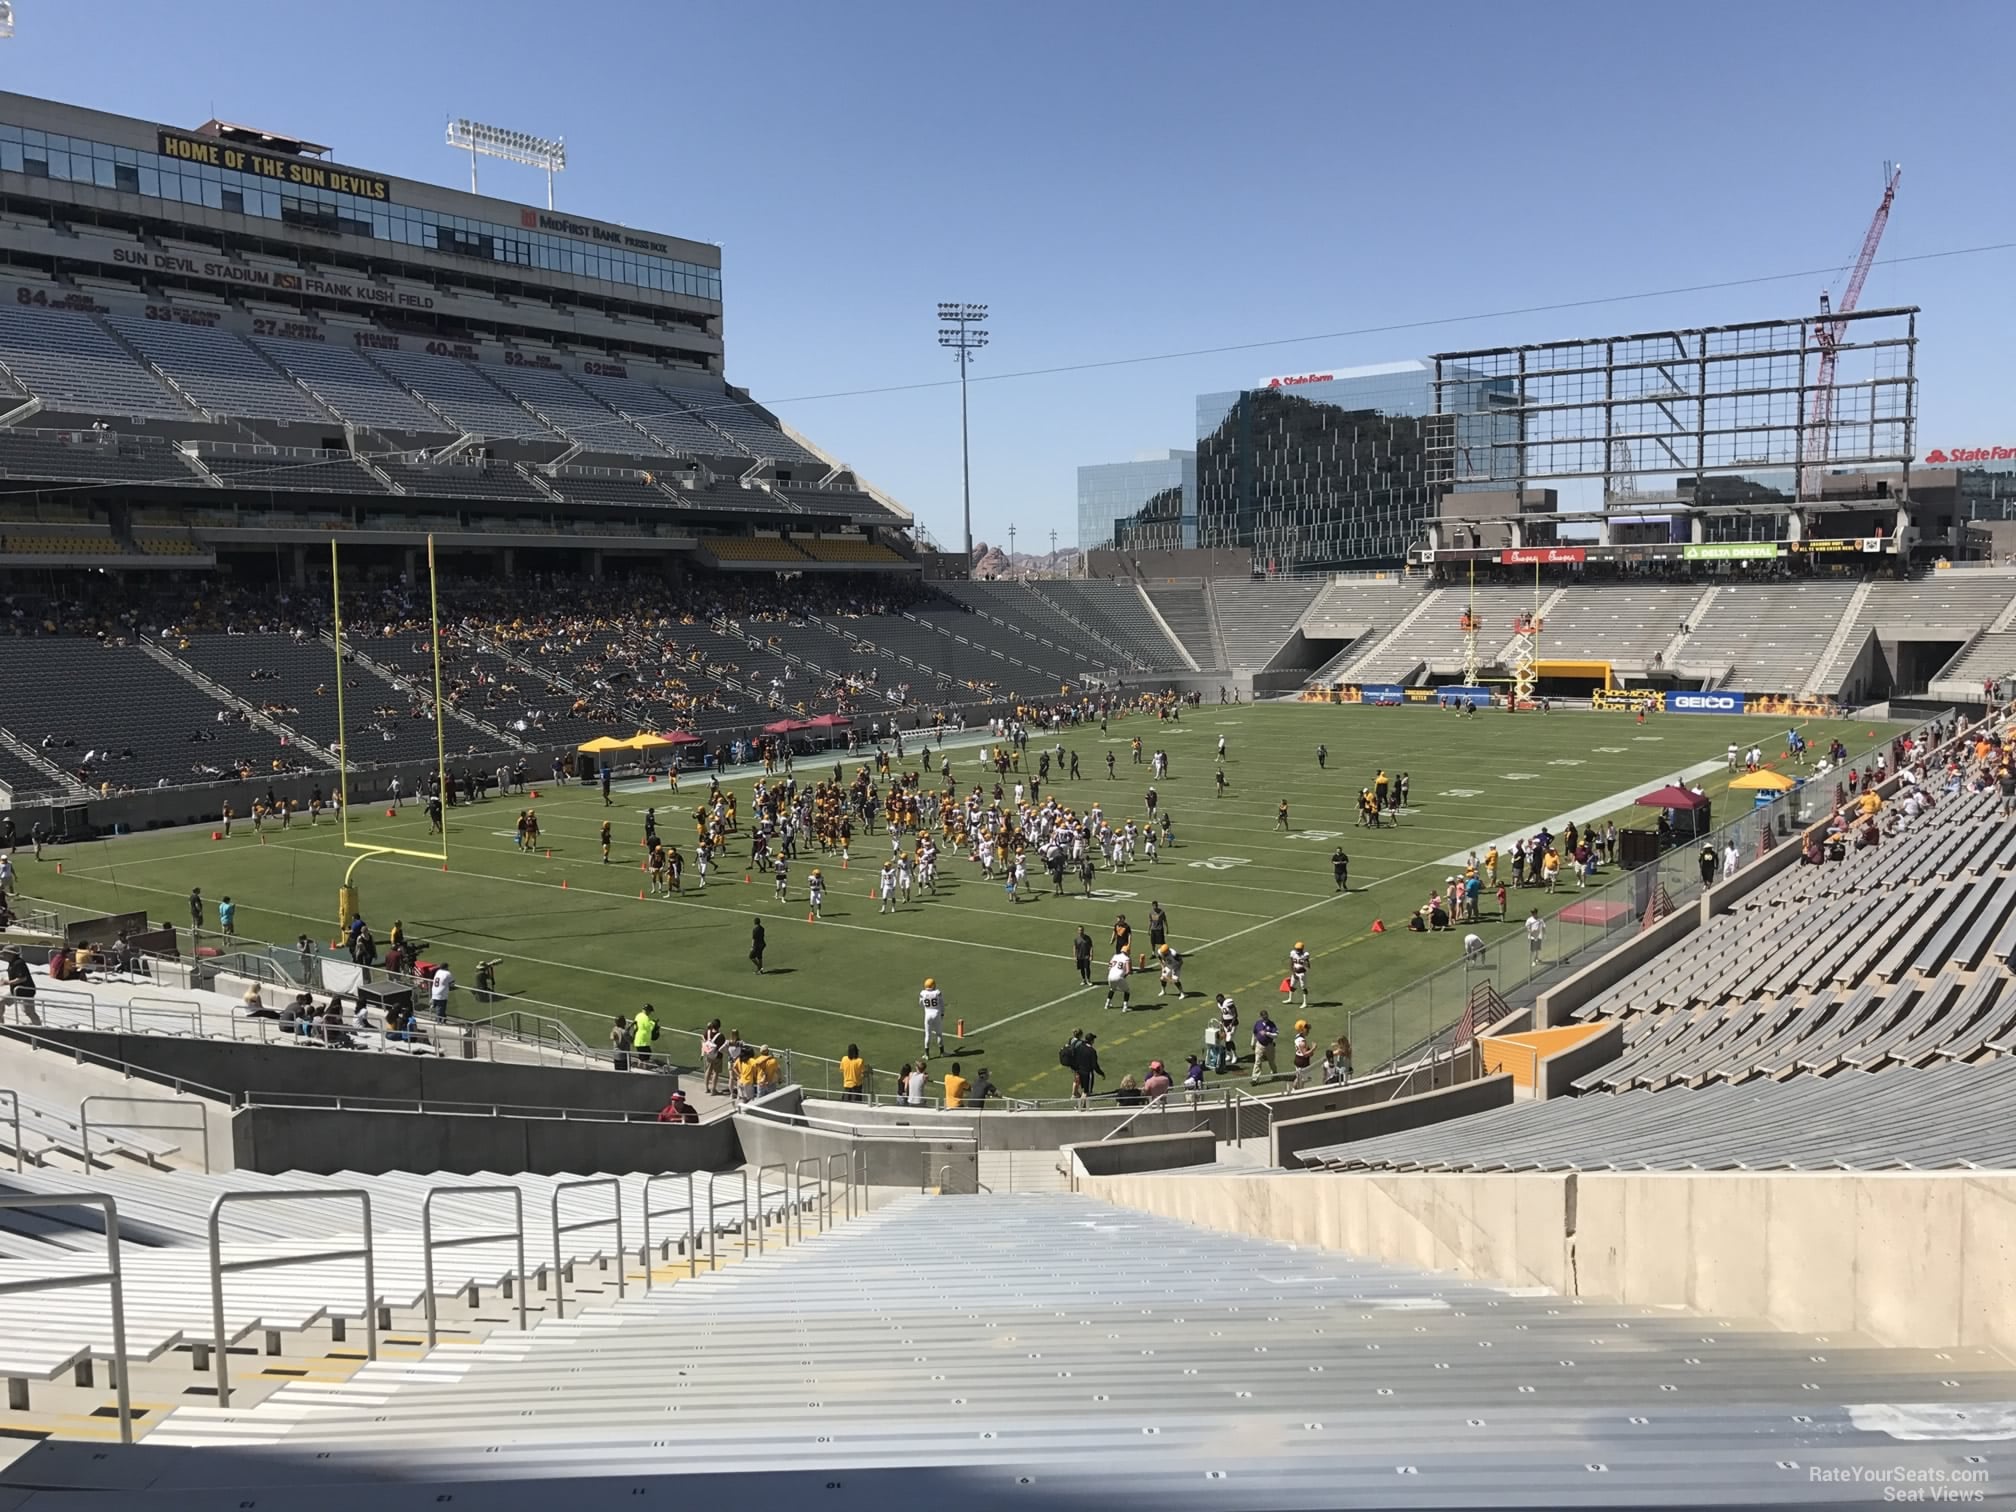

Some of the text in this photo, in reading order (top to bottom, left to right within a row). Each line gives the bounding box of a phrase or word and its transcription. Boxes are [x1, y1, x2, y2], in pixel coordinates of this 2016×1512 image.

[165, 136, 385, 199] HOME OF THE SUN DEVILS
[593, 225, 621, 244] BANK
[113, 248, 149, 266] SUN
[154, 254, 199, 274] DEVIL
[204, 262, 269, 285] STADIUM
[305, 278, 352, 298] FRANK
[357, 285, 394, 303] KUSH
[399, 292, 434, 309] FIELD
[17, 287, 48, 306] 84
[145, 305, 171, 321] 33
[253, 318, 276, 335] 27
[353, 332, 369, 347] 11
[426, 341, 448, 356] 40
[505, 351, 523, 366] 52
[584, 362, 601, 376] 62
[1284, 375, 1308, 386] State
[1950, 448, 1990, 462] State
[1701, 547, 1773, 558] DELTA DENTAL
[1675, 696, 1735, 709] GEICO
[1111, 960, 1124, 970] 79
[924, 998, 938, 1008] 96
[631, 1487, 646, 1496] 11
[825, 1481, 841, 1489] 10
